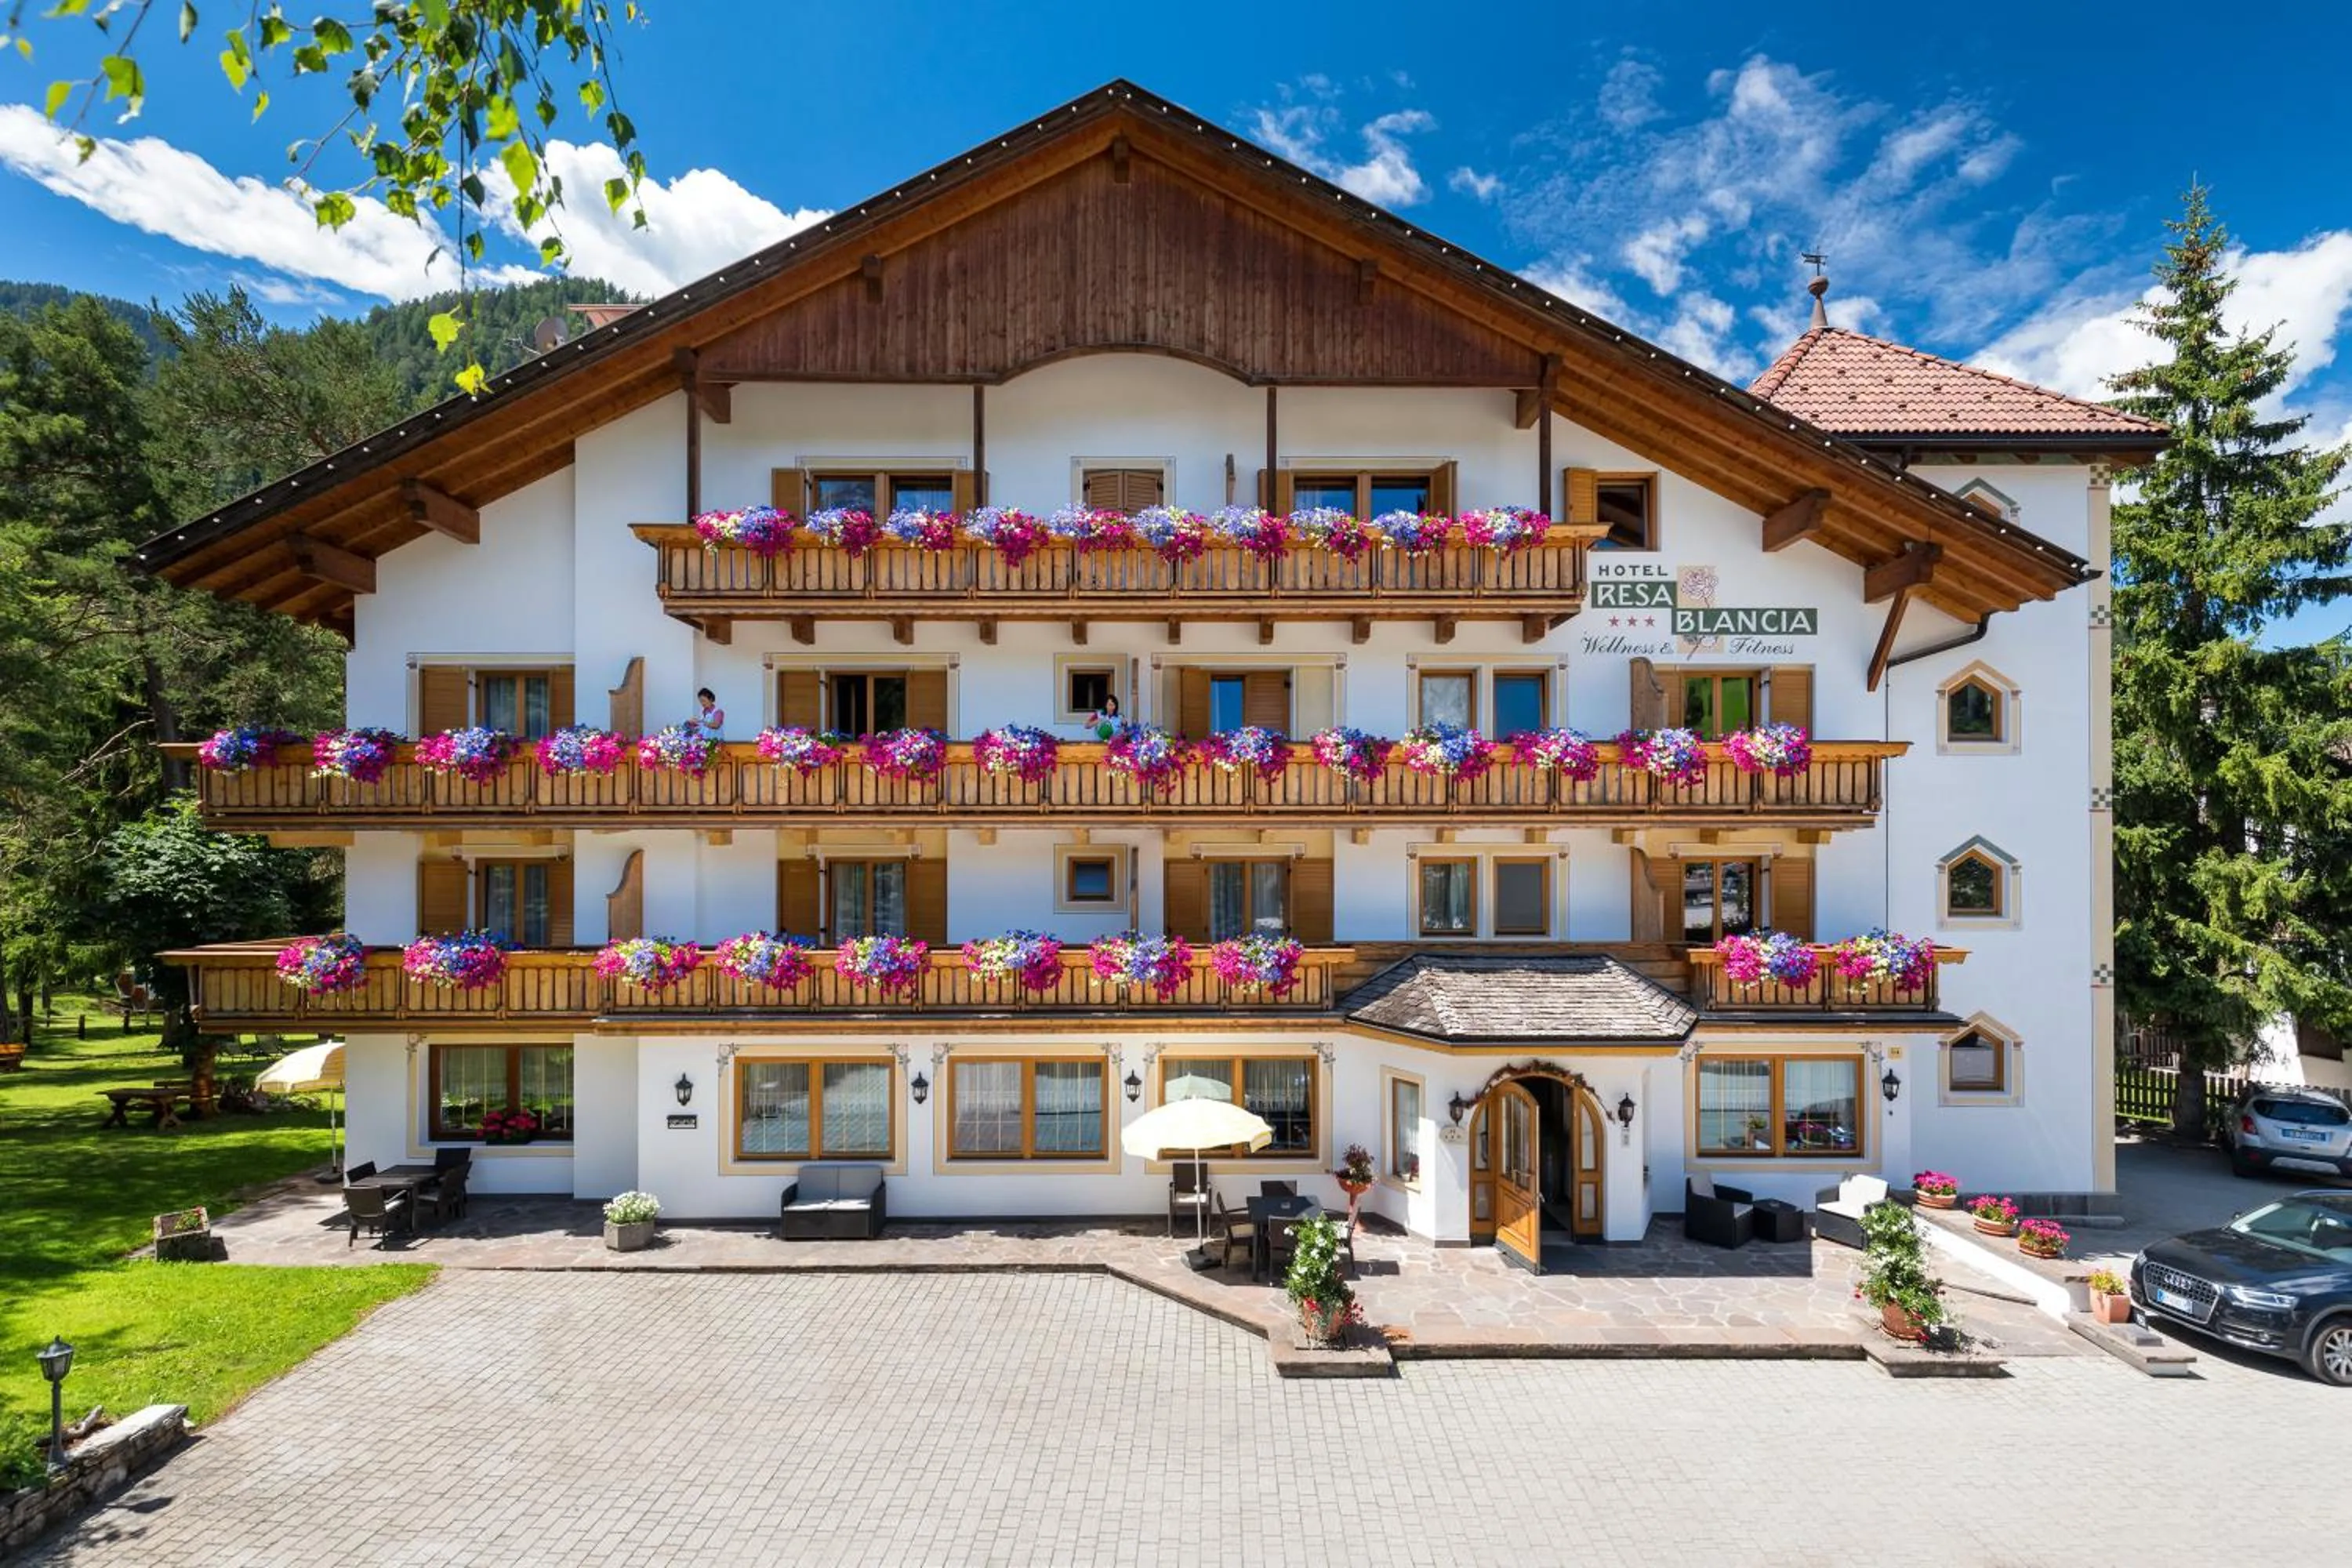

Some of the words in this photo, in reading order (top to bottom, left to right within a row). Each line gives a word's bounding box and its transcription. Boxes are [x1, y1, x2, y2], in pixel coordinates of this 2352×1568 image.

[1598, 564, 1669, 576] HOTEL
[1596, 584, 1674, 606] RESA
[1675, 610, 1813, 633] BLANCIA
[1581, 635, 1654, 654] Wellness
[1660, 642, 1675, 654] &
[1729, 637, 1795, 655] Fitness
